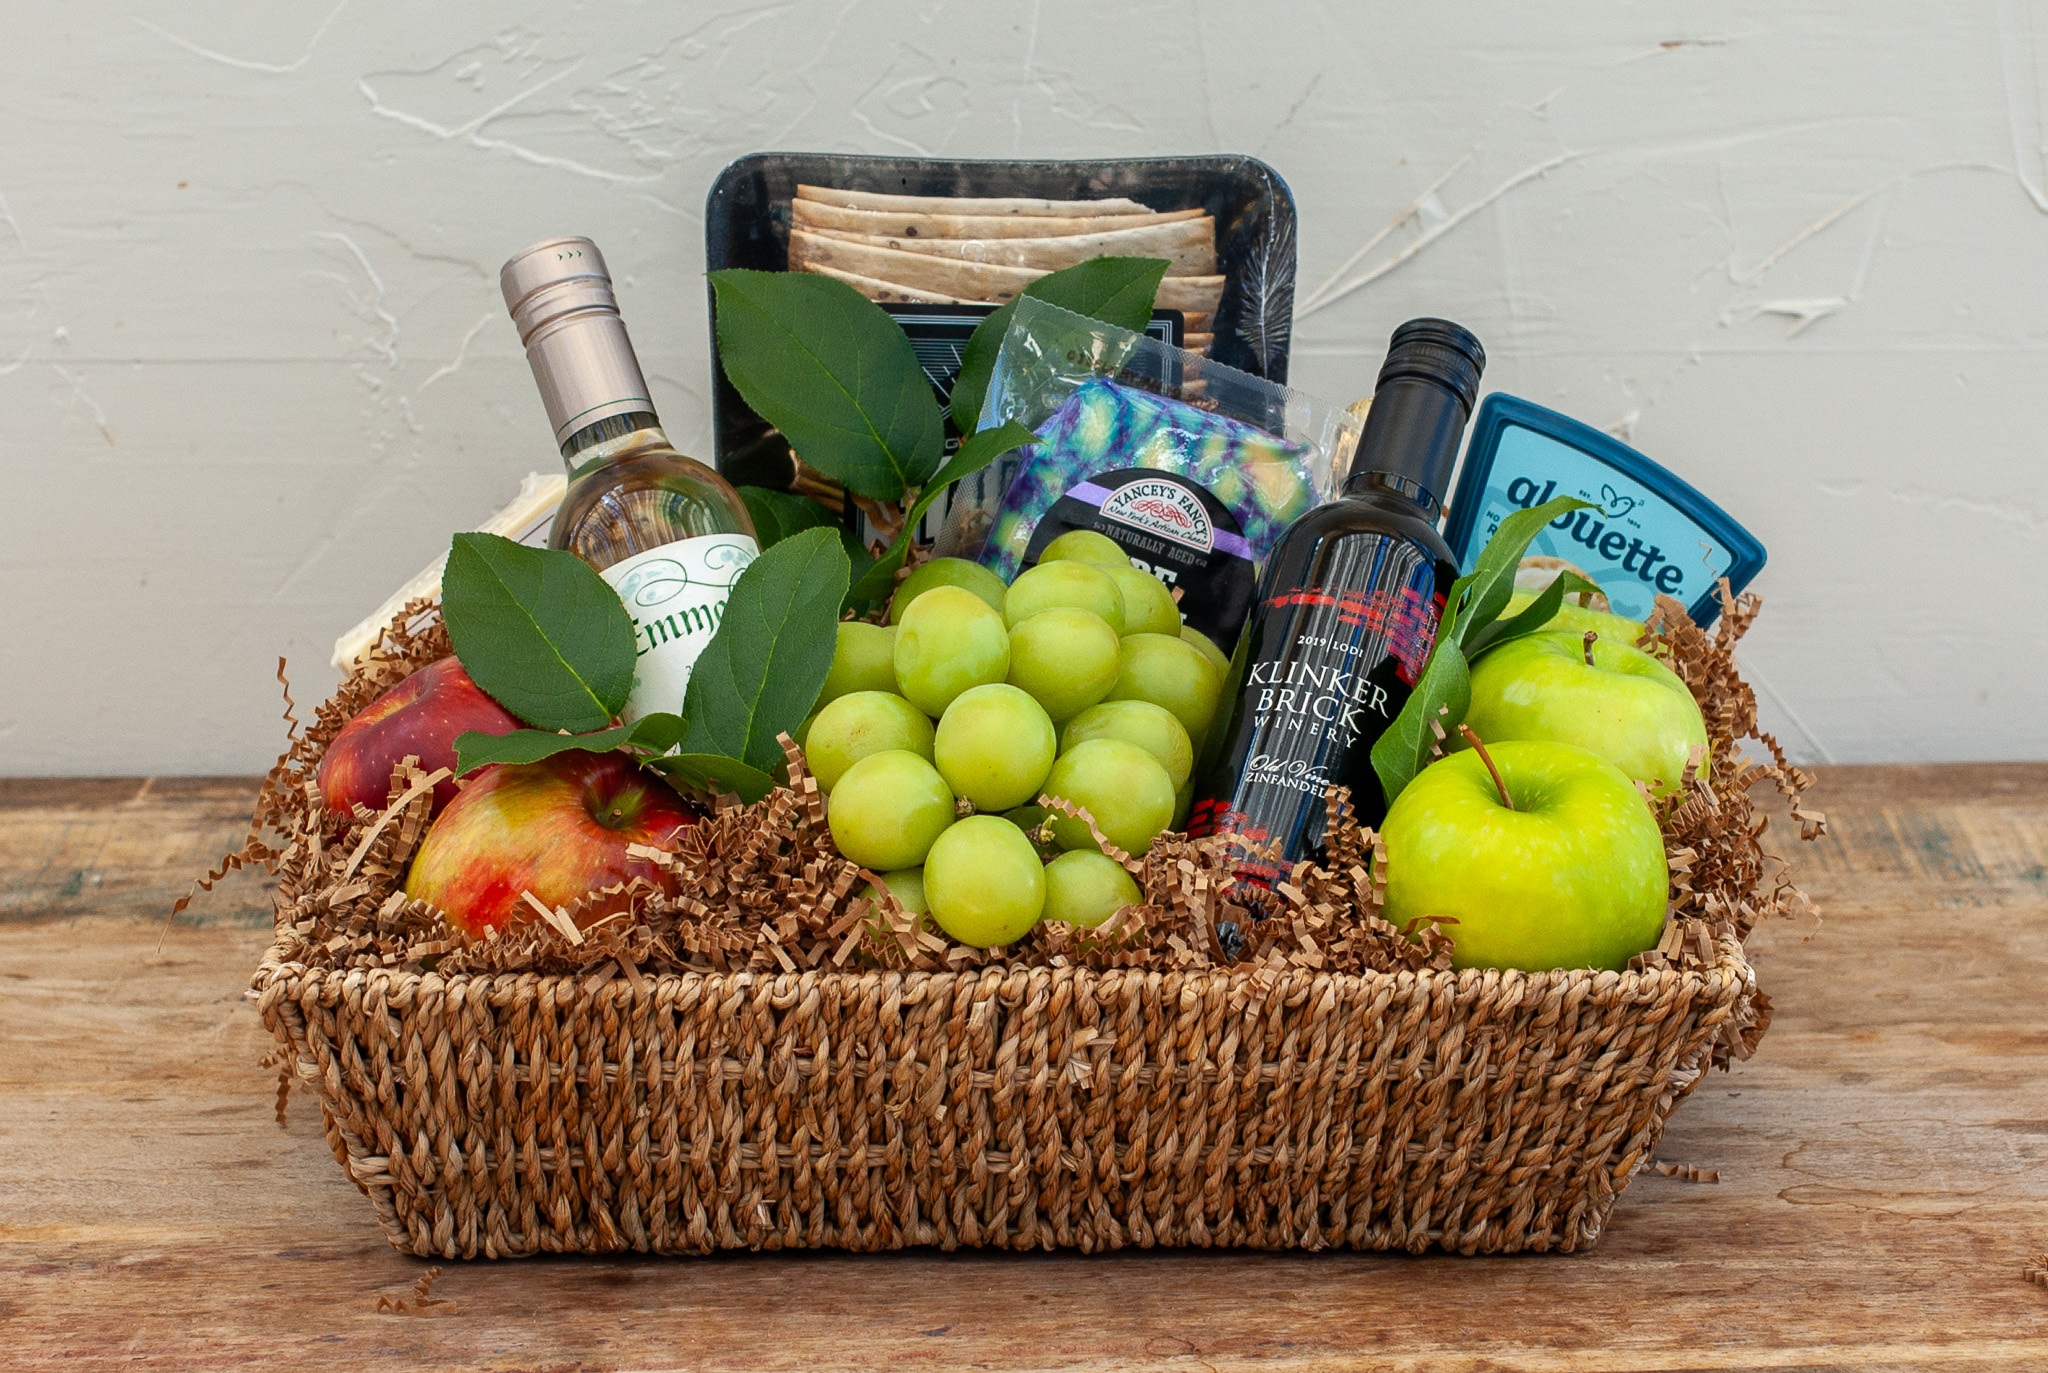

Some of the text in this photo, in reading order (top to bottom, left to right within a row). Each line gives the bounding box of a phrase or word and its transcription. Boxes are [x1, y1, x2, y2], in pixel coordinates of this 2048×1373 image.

[1113, 484, 1177, 508] YANCEY'S
[1107, 505, 1208, 545] New York's Artisan Cheese
[1105, 524, 1195, 565] NATURALLY AGED
[1247, 661, 1389, 719] KLINKER
[1255, 688, 1365, 734] BRICK
[1253, 716, 1357, 749] WINERY
[1245, 772, 1326, 799] ZINFANDEL
[1250, 754, 1329, 785] Old Vine
